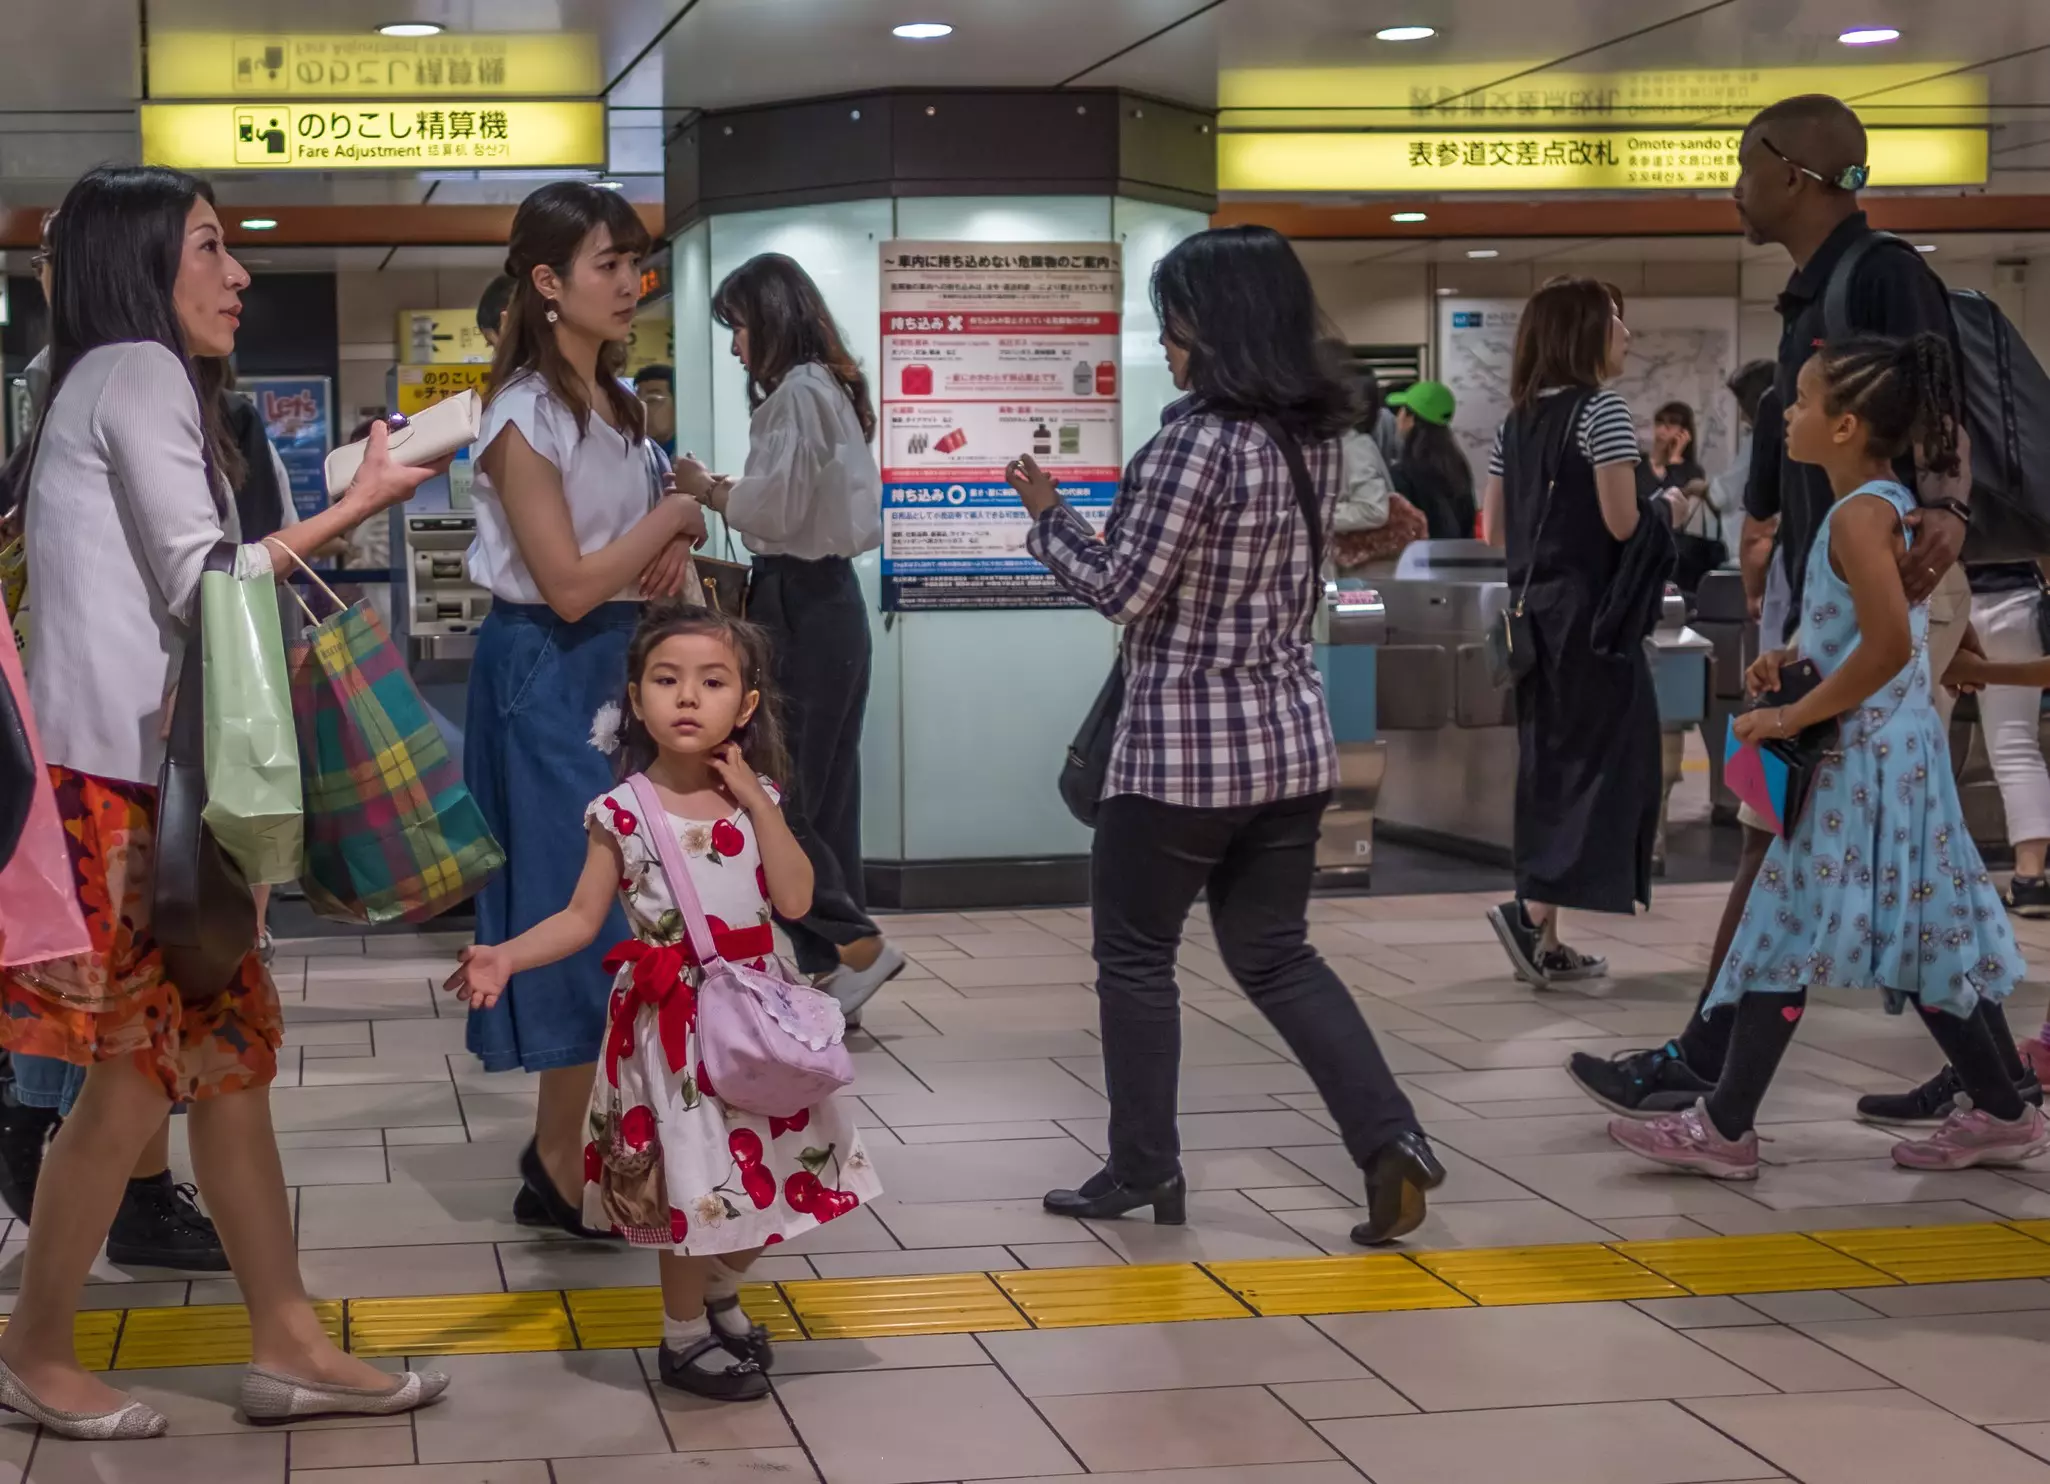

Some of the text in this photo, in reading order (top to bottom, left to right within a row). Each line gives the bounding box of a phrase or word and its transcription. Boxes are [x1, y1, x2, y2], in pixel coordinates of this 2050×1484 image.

[297, 109, 510, 140] のりこし精算機
[1627, 136, 1722, 151] Omote-sando
[298, 145, 329, 158] Fare
[334, 144, 422, 160] Adjustment
[1408, 140, 1620, 167] 表参道交差点改札
[890, 488, 945, 503] 持ち込み
